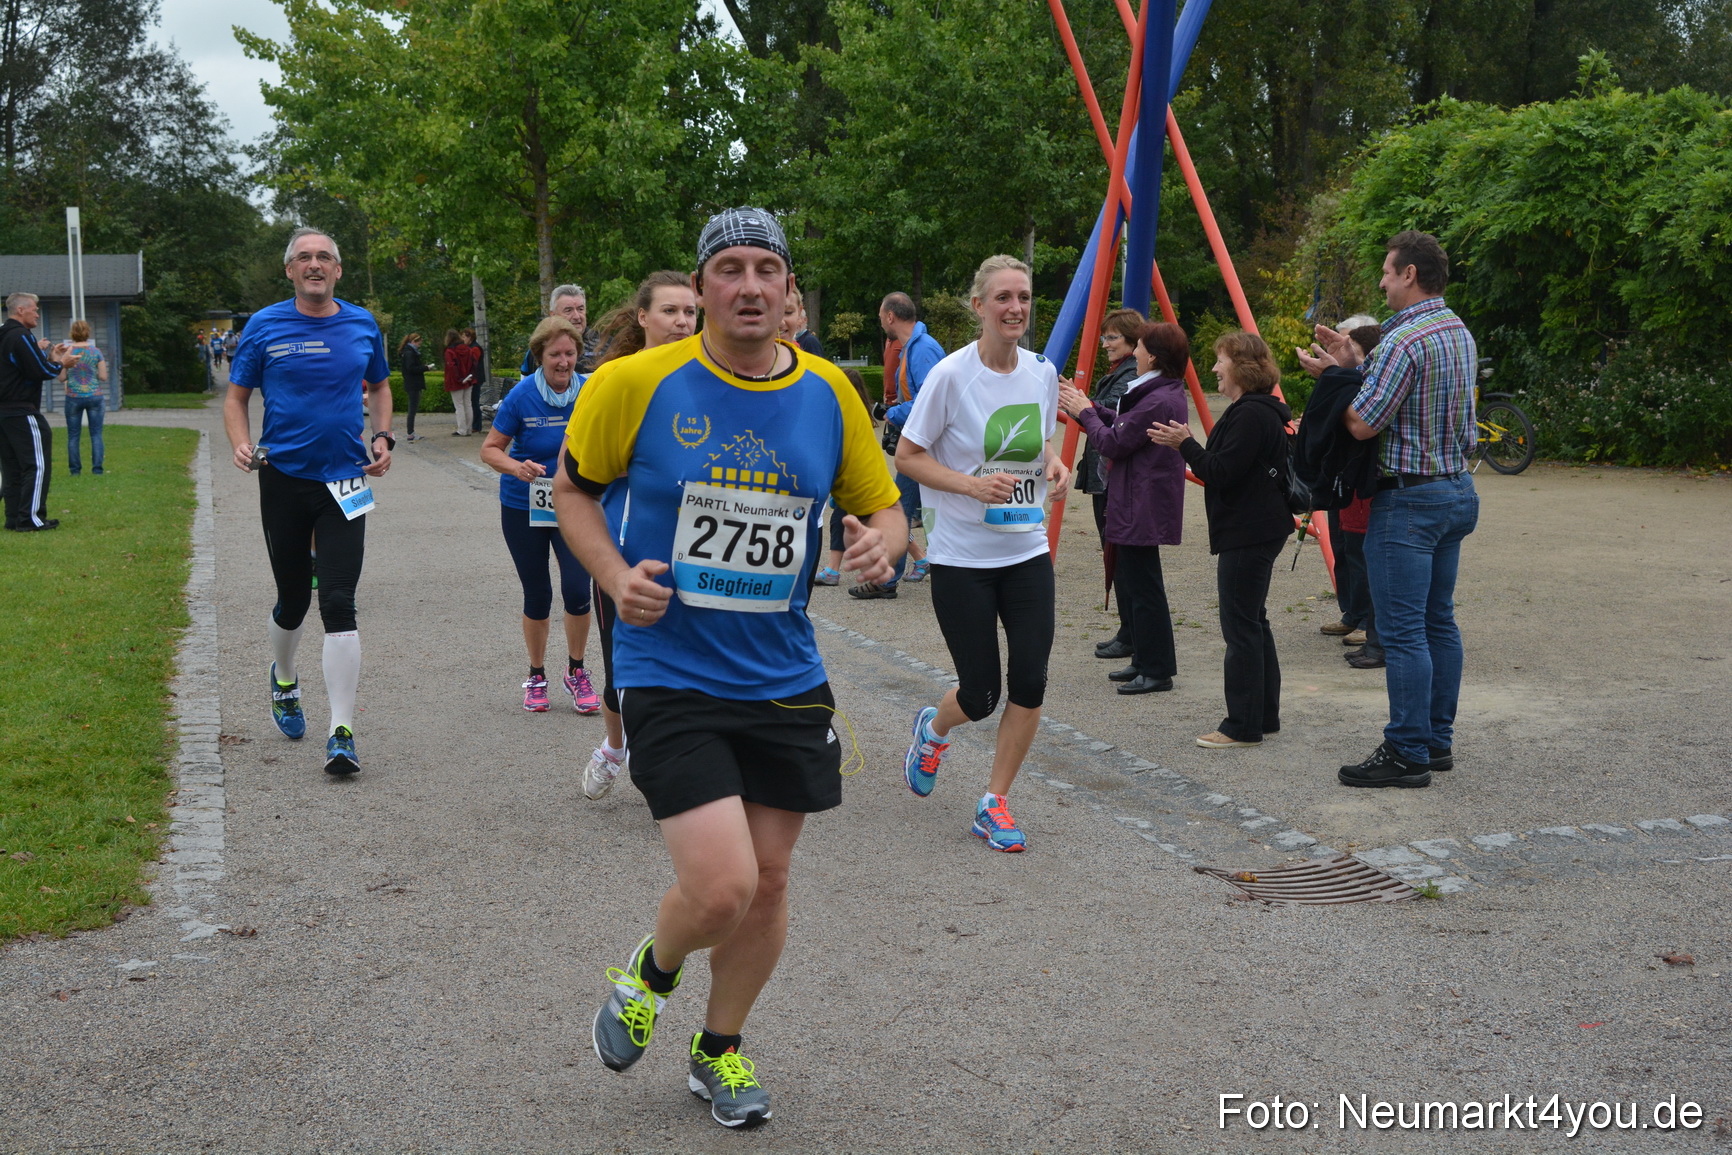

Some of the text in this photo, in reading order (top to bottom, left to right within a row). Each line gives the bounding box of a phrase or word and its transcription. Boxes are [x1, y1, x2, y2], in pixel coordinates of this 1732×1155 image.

[680, 427, 702, 435] Jahre
[686, 494, 789, 518] PARTL Neumarkt
[1003, 511, 1030, 522] Miriam
[688, 515, 795, 568] 2758
[698, 572, 773, 596] Siegfried
